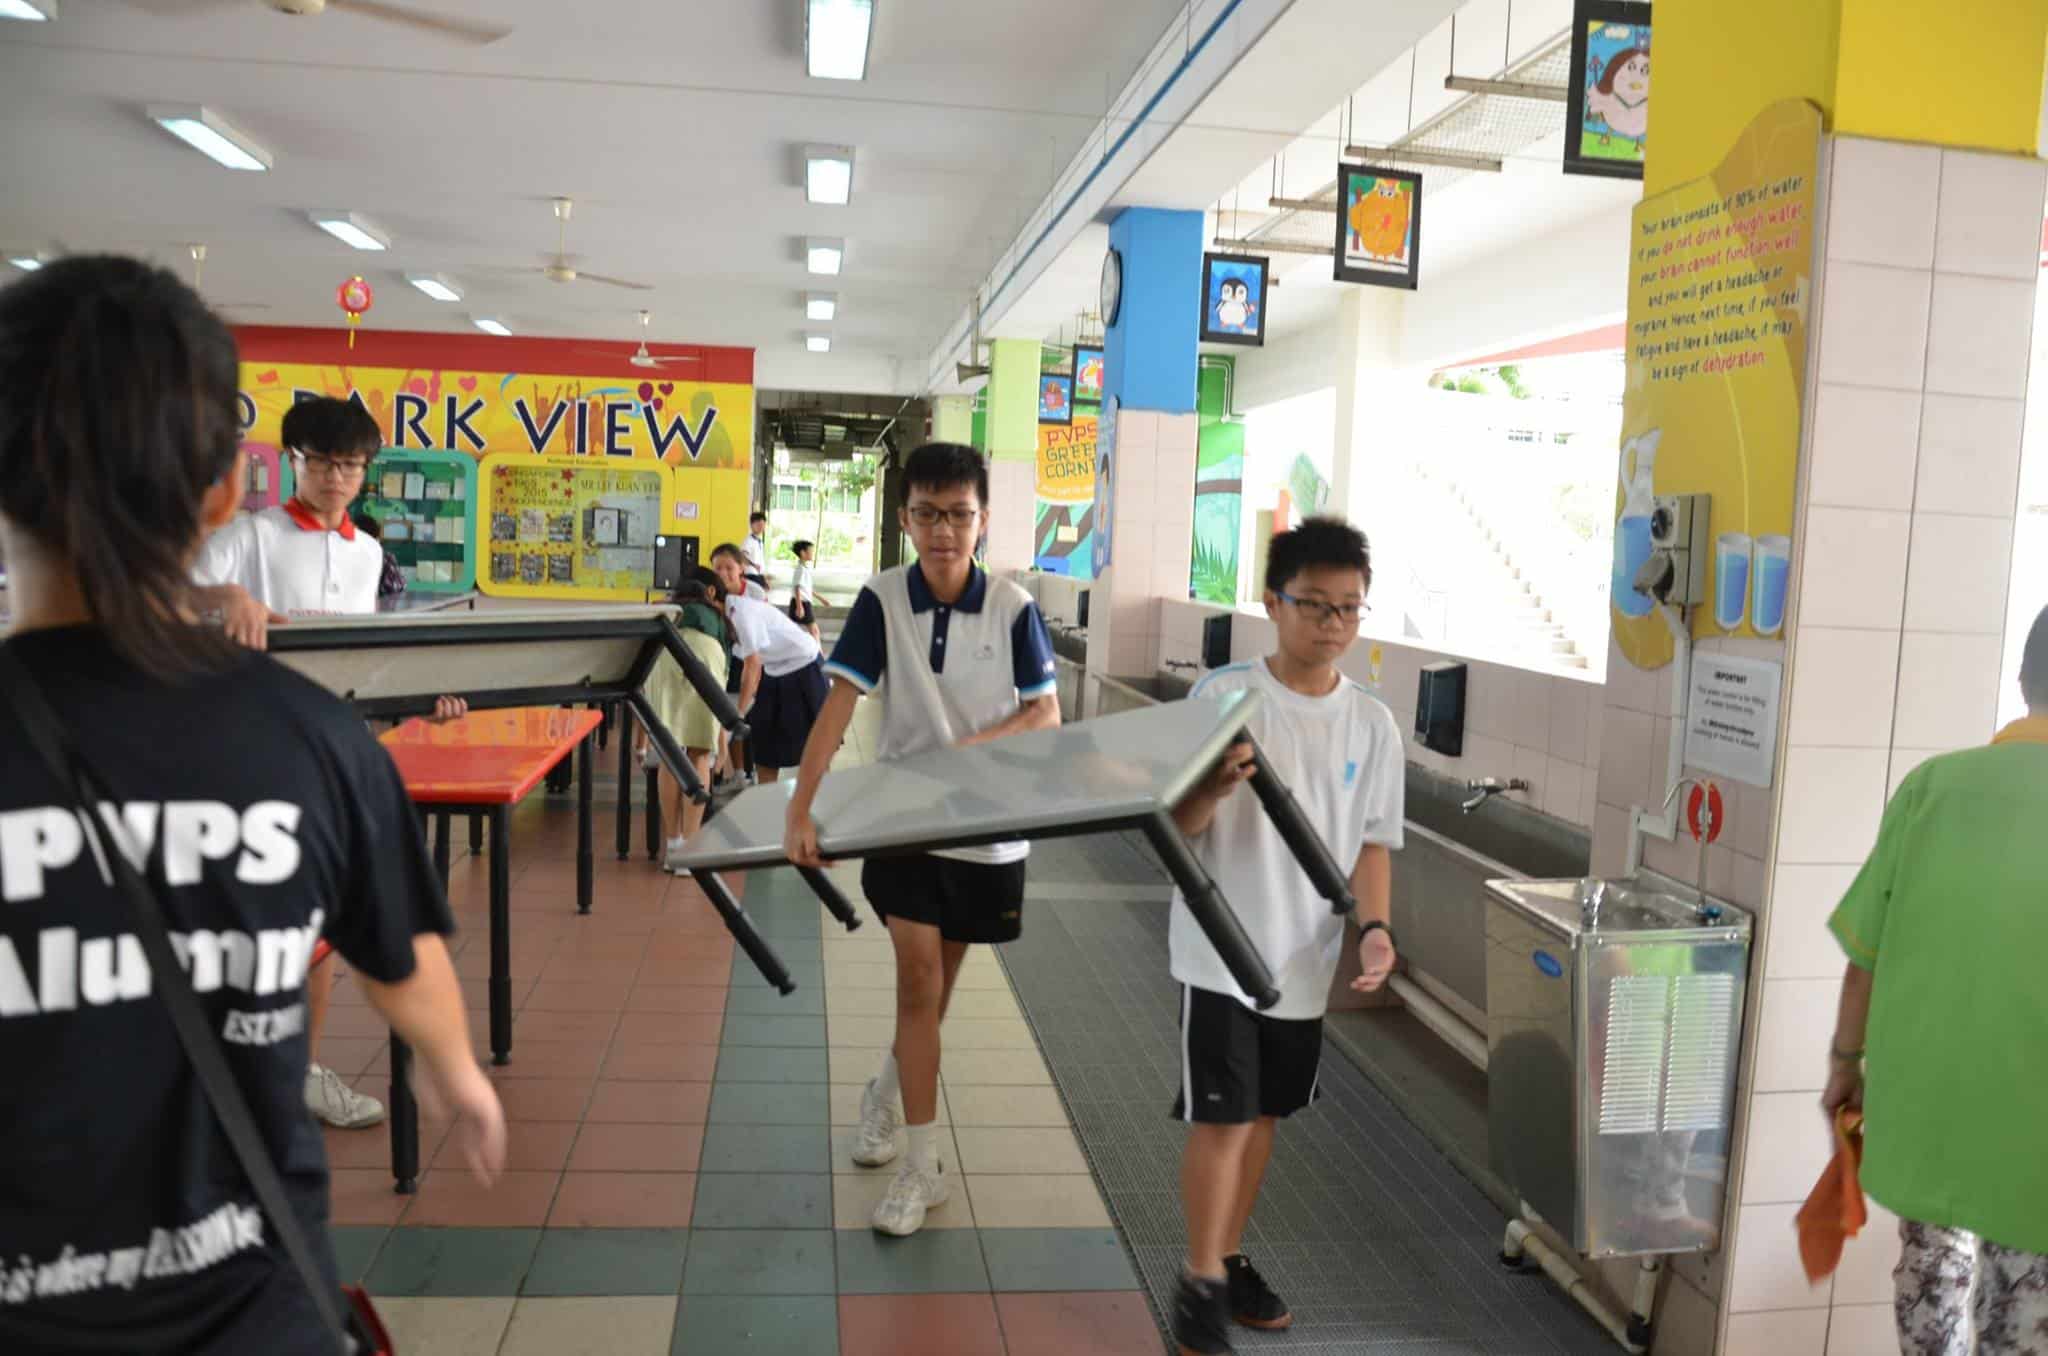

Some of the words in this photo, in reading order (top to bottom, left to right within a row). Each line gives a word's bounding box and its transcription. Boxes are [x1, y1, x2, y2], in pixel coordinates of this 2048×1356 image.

[1661, 214, 1683, 230] brain
[1684, 203, 1719, 223] consists
[1722, 196, 1733, 212] of
[1758, 184, 1769, 201] of
[1646, 247, 1661, 262] you
[1663, 240, 1674, 257] do
[1675, 231, 1693, 250] not
[1695, 224, 1721, 246] drink
[1725, 208, 1764, 239] enough
[1641, 271, 1658, 288] your
[1660, 263, 1684, 279] brain
[1687, 249, 1721, 272] cannot
[1726, 240, 1769, 265] function
[1648, 290, 1663, 308] and
[1664, 287, 1680, 305] you
[1682, 283, 1697, 299] will
[1700, 280, 1714, 301] get
[1725, 268, 1770, 289] headache
[1701, 304, 1720, 319] next
[1760, 293, 1777, 312] you
[1781, 287, 1800, 306] feel
[1665, 336, 1680, 353] and
[1683, 334, 1702, 350] have
[515, 398, 717, 460] VIEW
[1046, 440, 1097, 462] GREE
[0, 800, 303, 902] PVPS
